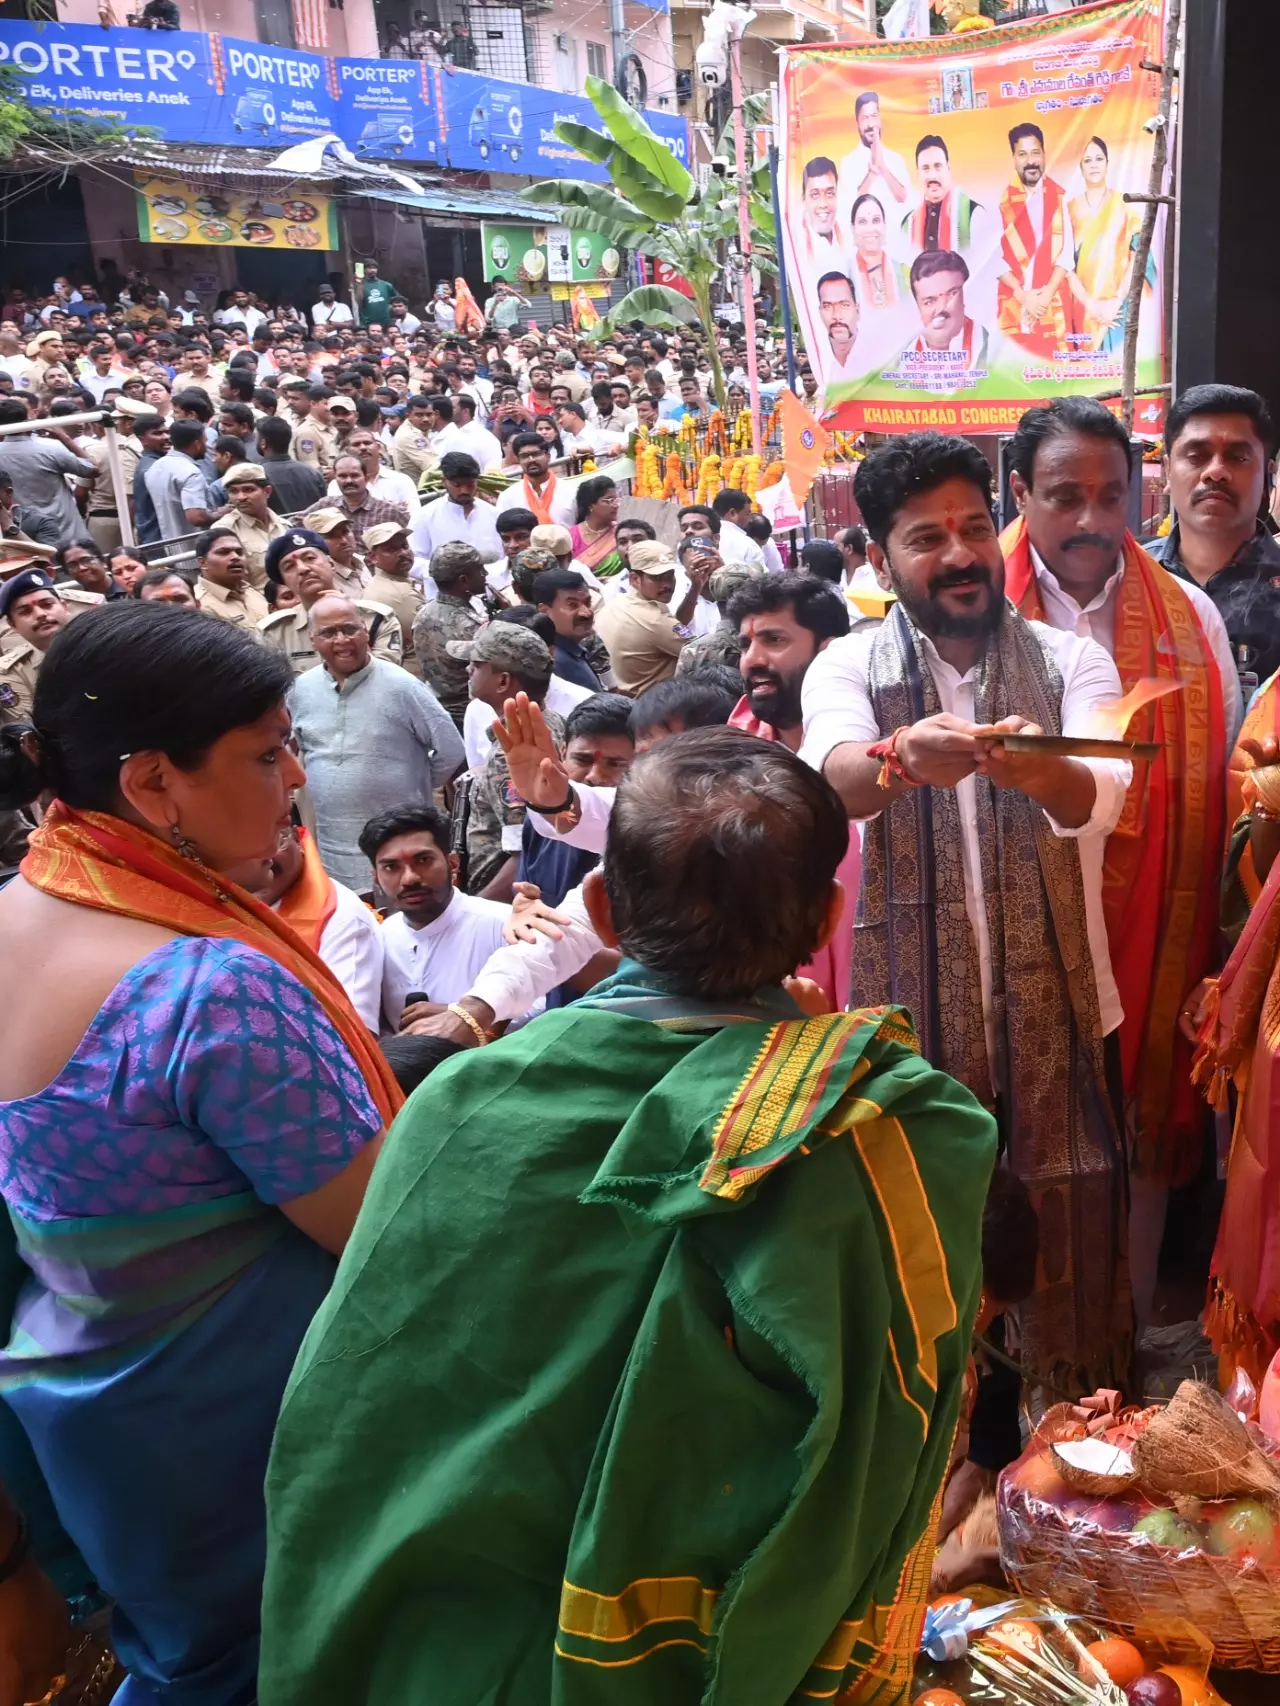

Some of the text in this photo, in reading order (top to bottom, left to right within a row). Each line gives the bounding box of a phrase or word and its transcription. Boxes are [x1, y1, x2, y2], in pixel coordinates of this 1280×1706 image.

[229, 49, 314, 89] PORTER
[342, 66, 409, 83] PORTER
[31, 84, 56, 101] Ek,
[60, 86, 143, 103] Deliveries
[147, 91, 191, 105] Anek
[900, 351, 967, 362] TPCC SECRETARY
[863, 407, 957, 424] KHAIRATABAD
